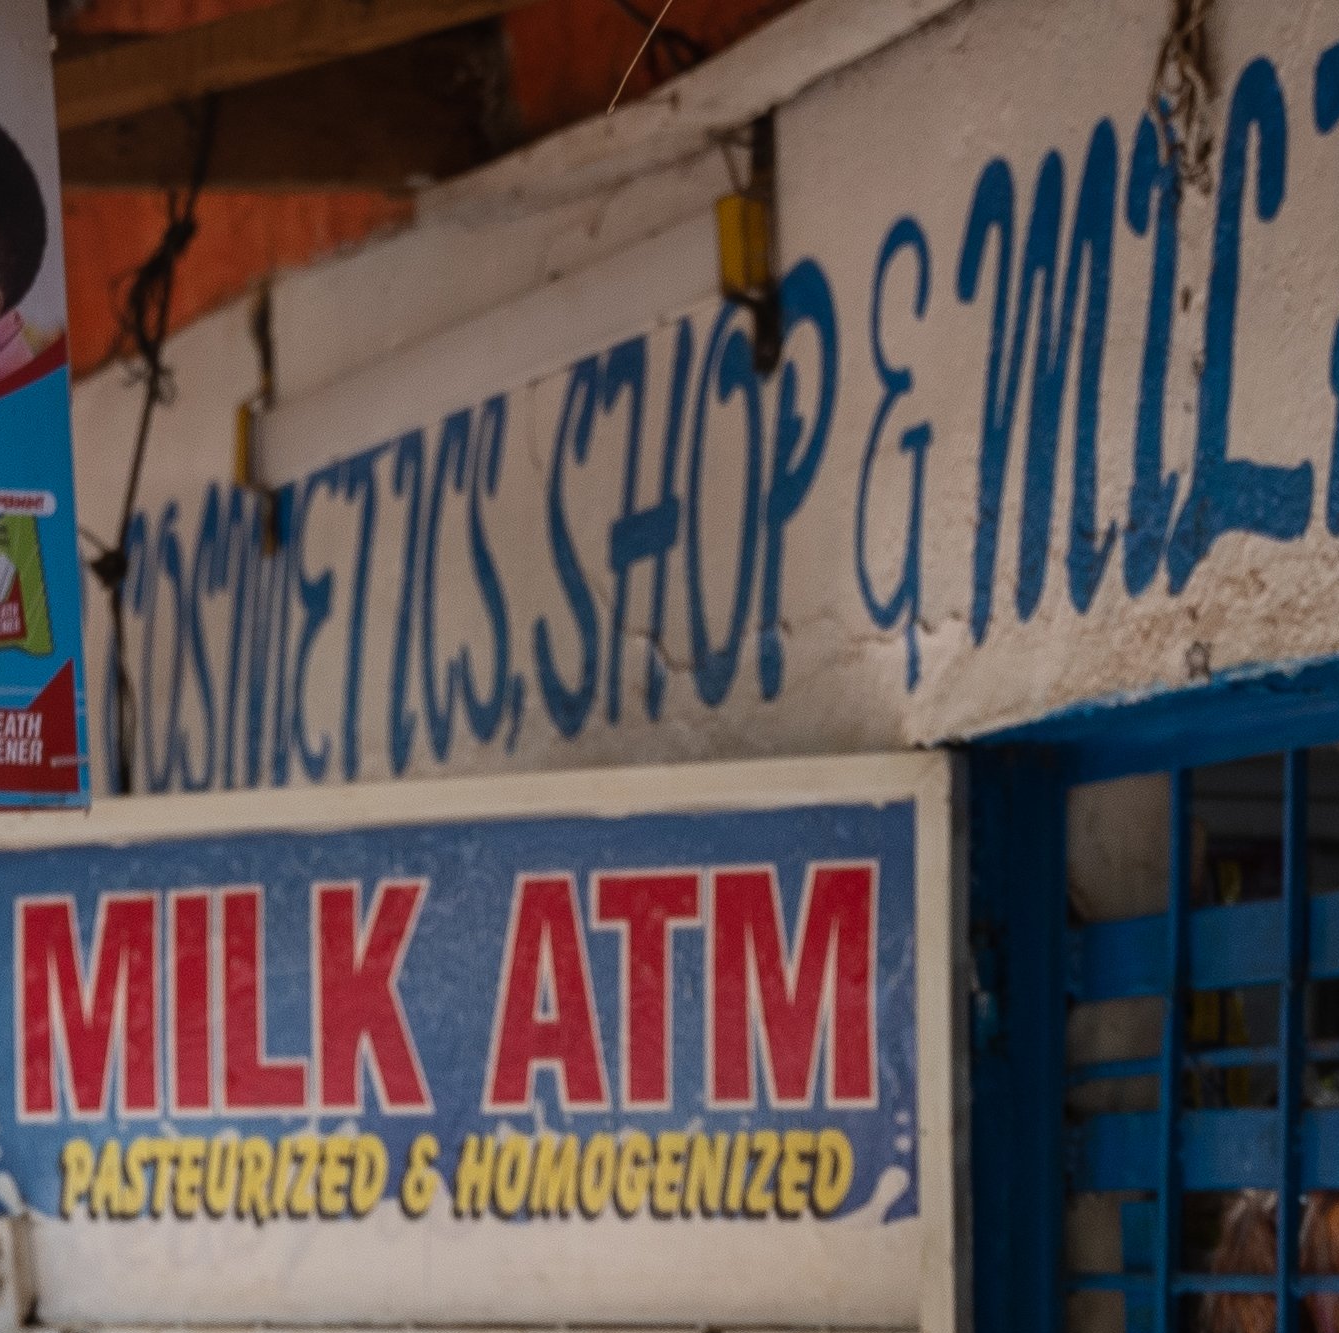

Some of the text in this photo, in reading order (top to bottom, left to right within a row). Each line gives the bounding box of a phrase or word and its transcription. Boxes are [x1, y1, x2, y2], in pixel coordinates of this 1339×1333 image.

[532, 257, 839, 740] SHOP
[856, 215, 933, 694] &
[13, 859, 881, 1123] MILK ATM
[60, 1129, 392, 1223] PASTEURIZED
[454, 1127, 857, 1222] HOMOGENIZED
